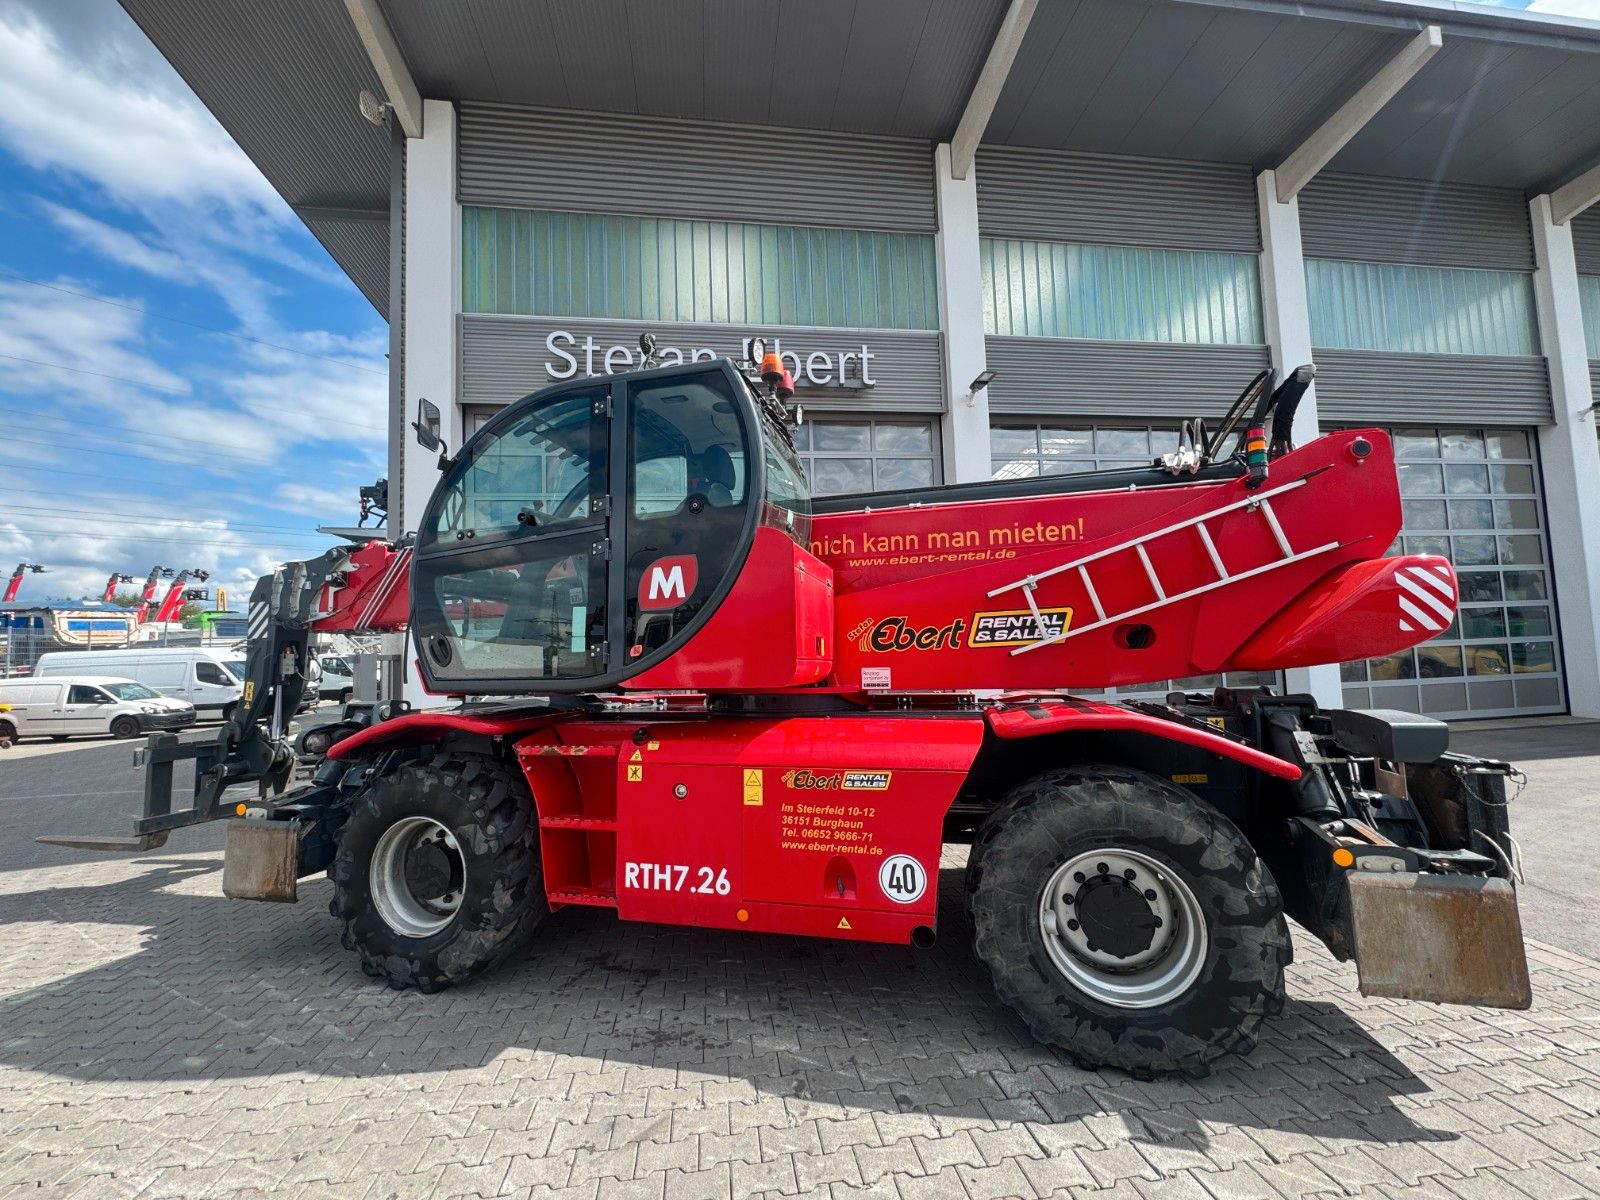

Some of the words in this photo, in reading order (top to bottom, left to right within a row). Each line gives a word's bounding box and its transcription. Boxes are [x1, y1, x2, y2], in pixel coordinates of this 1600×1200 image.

[863, 530, 919, 552] kann
[928, 530, 978, 548] man
[989, 518, 1085, 545] mieten!
[849, 549, 1016, 567] www.ebert-rental.de
[648, 565, 686, 600] M
[847, 617, 874, 642] Stefan
[978, 614, 1063, 629] RENTAL
[871, 616, 966, 652] Ebert
[975, 631, 992, 641] &
[793, 770, 841, 790] Ebert
[781, 803, 794, 813] Im
[796, 804, 845, 816] Steierfeld
[848, 806, 876, 818] 10-12
[781, 815, 811, 827] 36151
[812, 818, 864, 830] Burghaun
[782, 827, 799, 838] Tel.
[801, 829, 832, 840] 06652
[833, 832, 873, 842] 9666-71
[781, 842, 884, 856] www.ebert-rental.de
[624, 861, 732, 896] RTH7.26
[888, 863, 917, 894] 40
